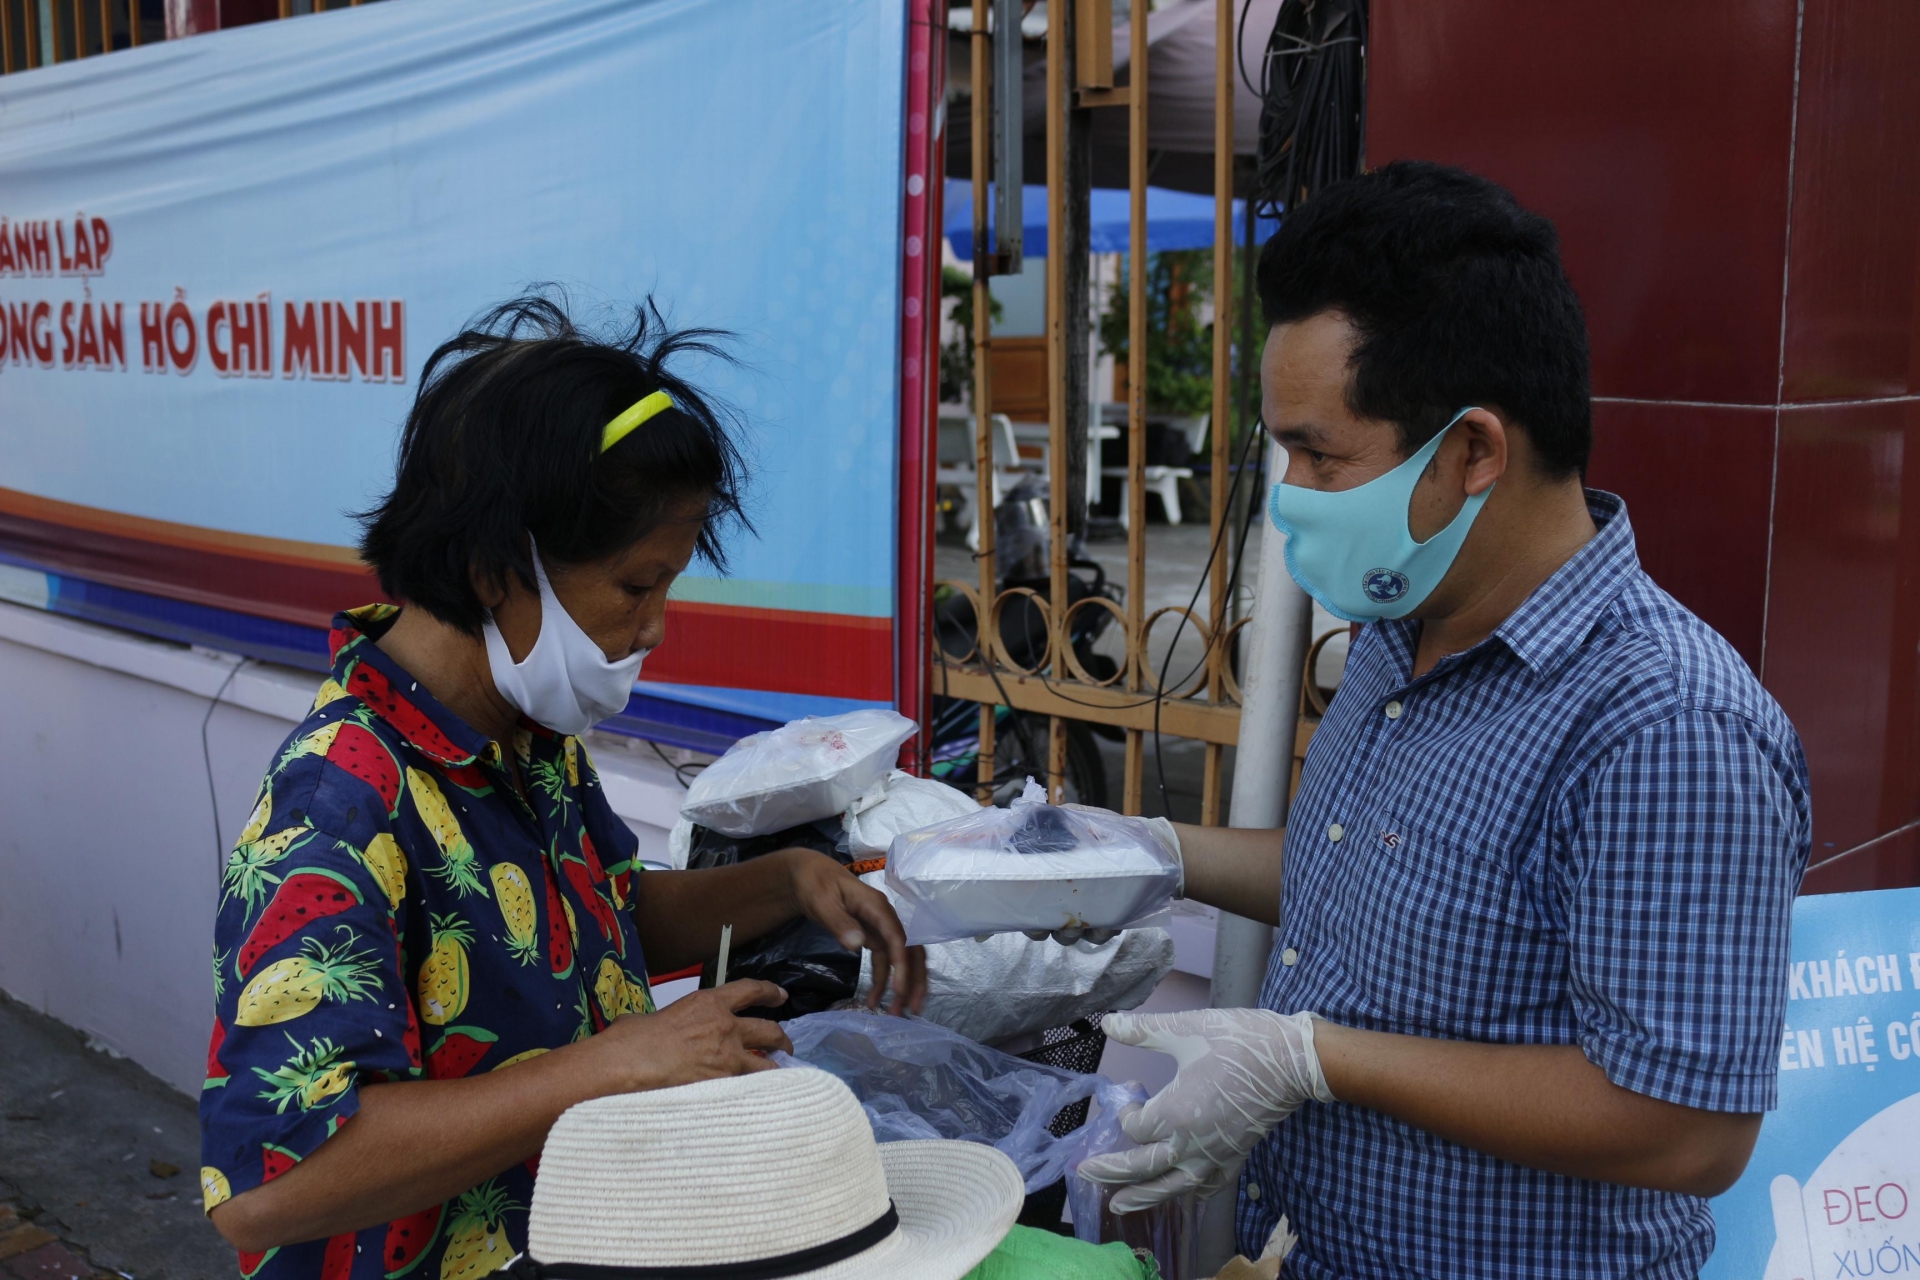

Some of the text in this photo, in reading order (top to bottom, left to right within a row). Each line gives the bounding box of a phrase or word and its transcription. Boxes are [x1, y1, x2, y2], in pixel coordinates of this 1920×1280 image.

[55, 211, 112, 279] LẬP
[0, 285, 406, 380] NG SẢN HỒ CHÍ MINH
[1789, 949, 1903, 1001] KHÁCH
[1831, 1016, 1880, 1072] HỆ
[1823, 1181, 1909, 1227] ĐEO
